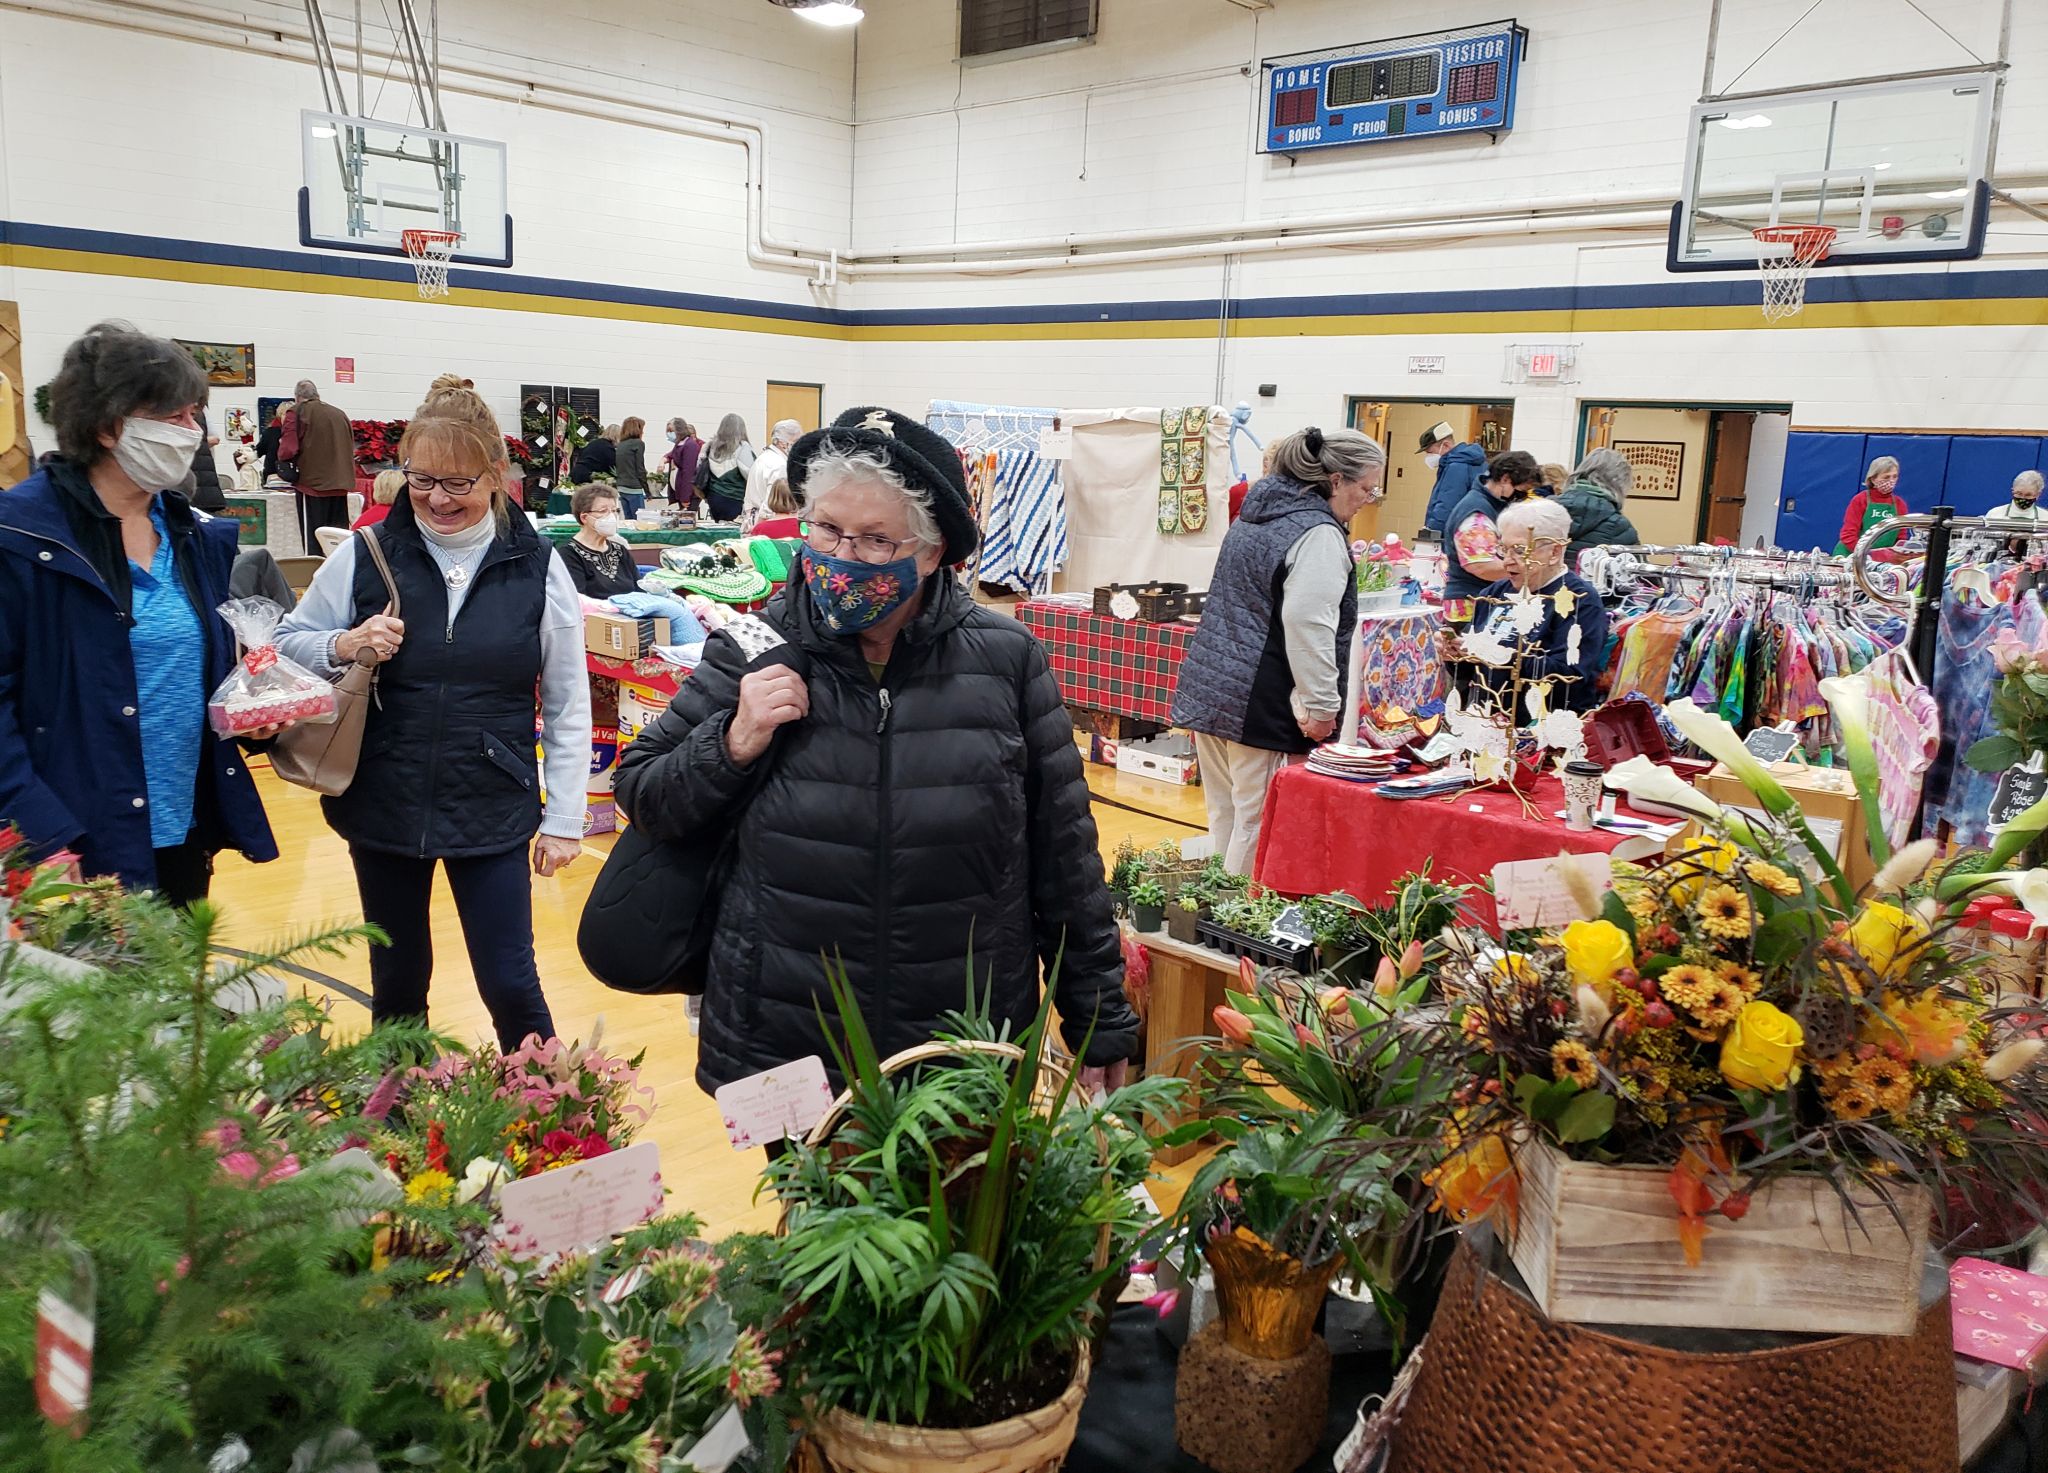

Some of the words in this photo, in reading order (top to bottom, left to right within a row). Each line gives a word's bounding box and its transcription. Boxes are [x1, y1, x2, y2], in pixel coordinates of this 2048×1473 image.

[1445, 39, 1505, 64] VISITOR
[1276, 66, 1321, 89] HOME
[1438, 107, 1478, 126] BONUS
[1288, 126, 1322, 144] BONUS
[1352, 119, 1387, 136] PERIOD
[1532, 355, 1556, 373] EXIT
[592, 730, 600, 739] al
